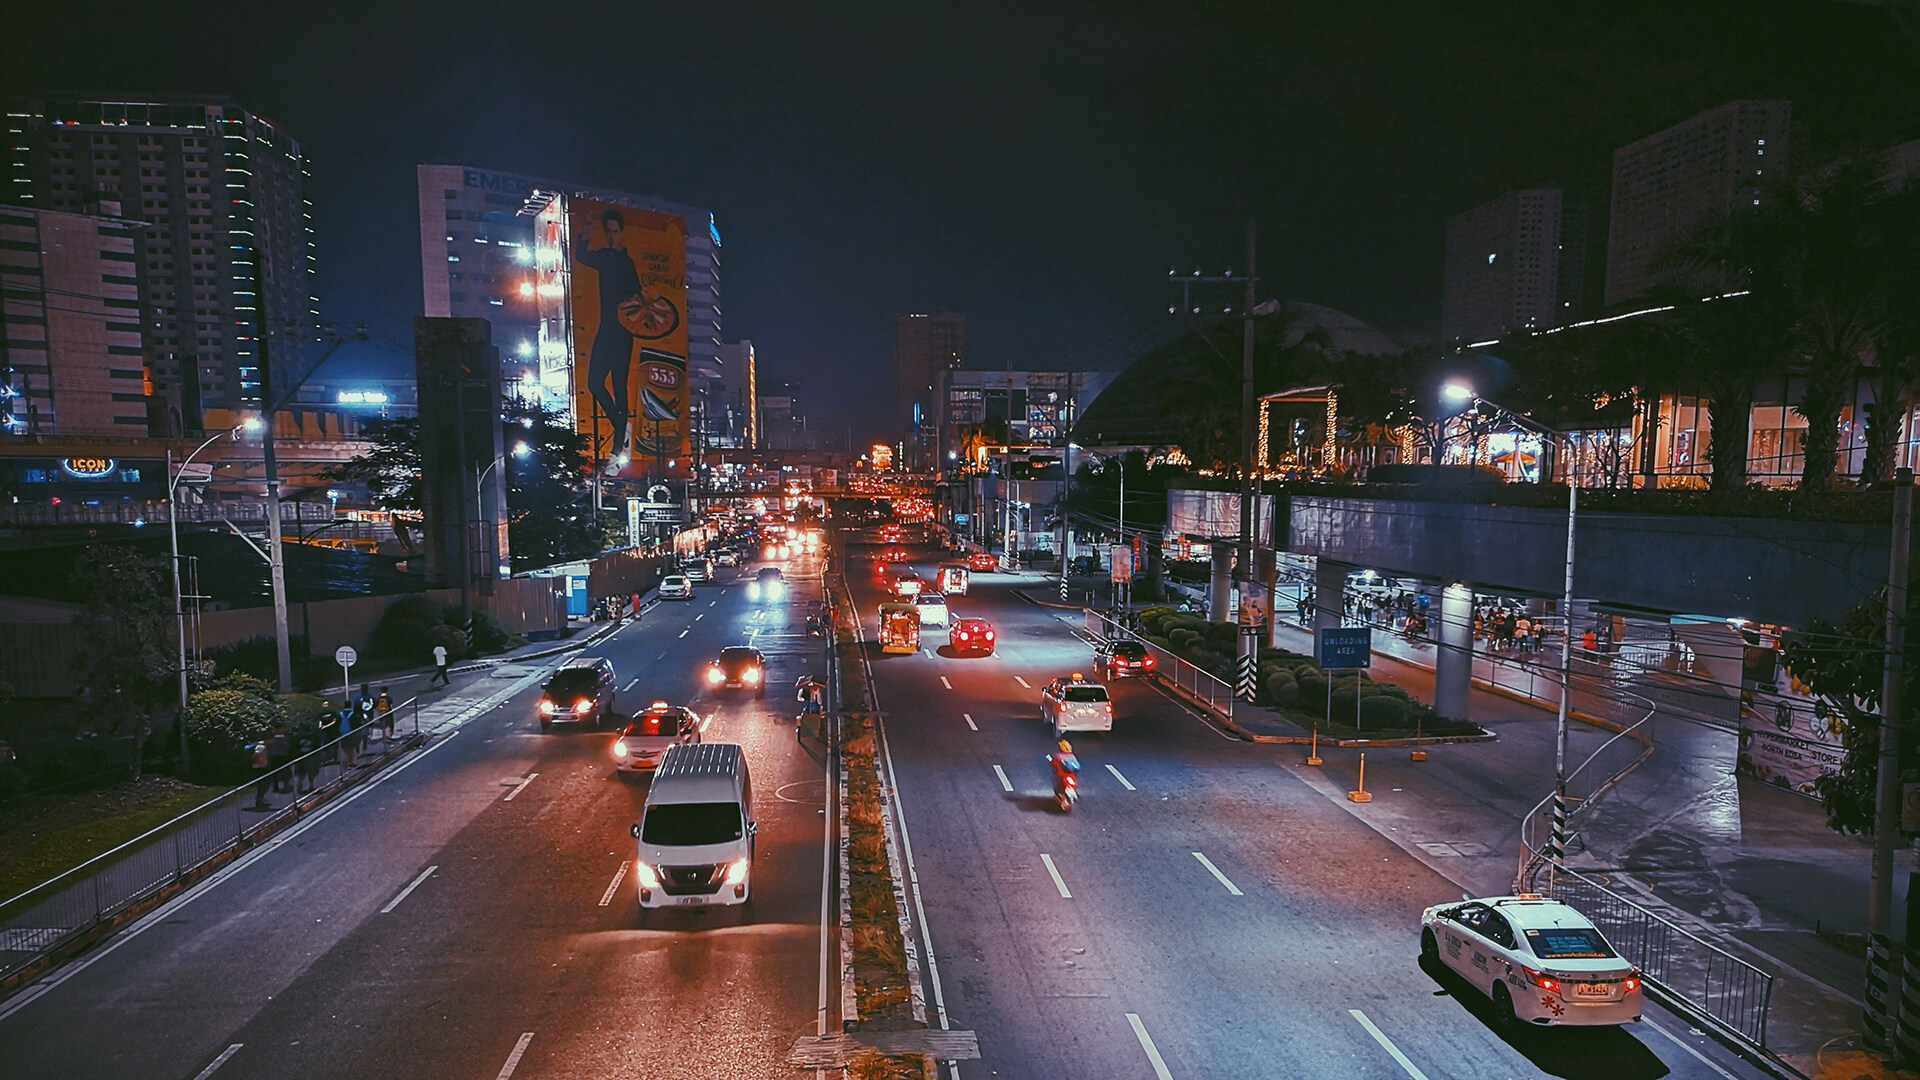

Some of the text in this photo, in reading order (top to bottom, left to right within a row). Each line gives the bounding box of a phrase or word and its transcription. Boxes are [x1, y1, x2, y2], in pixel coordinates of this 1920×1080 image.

[651, 367, 675, 385] 555
[73, 459, 105, 468] ICON
[1325, 637, 1368, 645] UNLOADING
[1336, 647, 1356, 655] AREA
[1756, 729, 1810, 750] HYPERMARKET
[1761, 743, 1803, 761] NORTH EDSA
[1811, 751, 1838, 765] STORE
